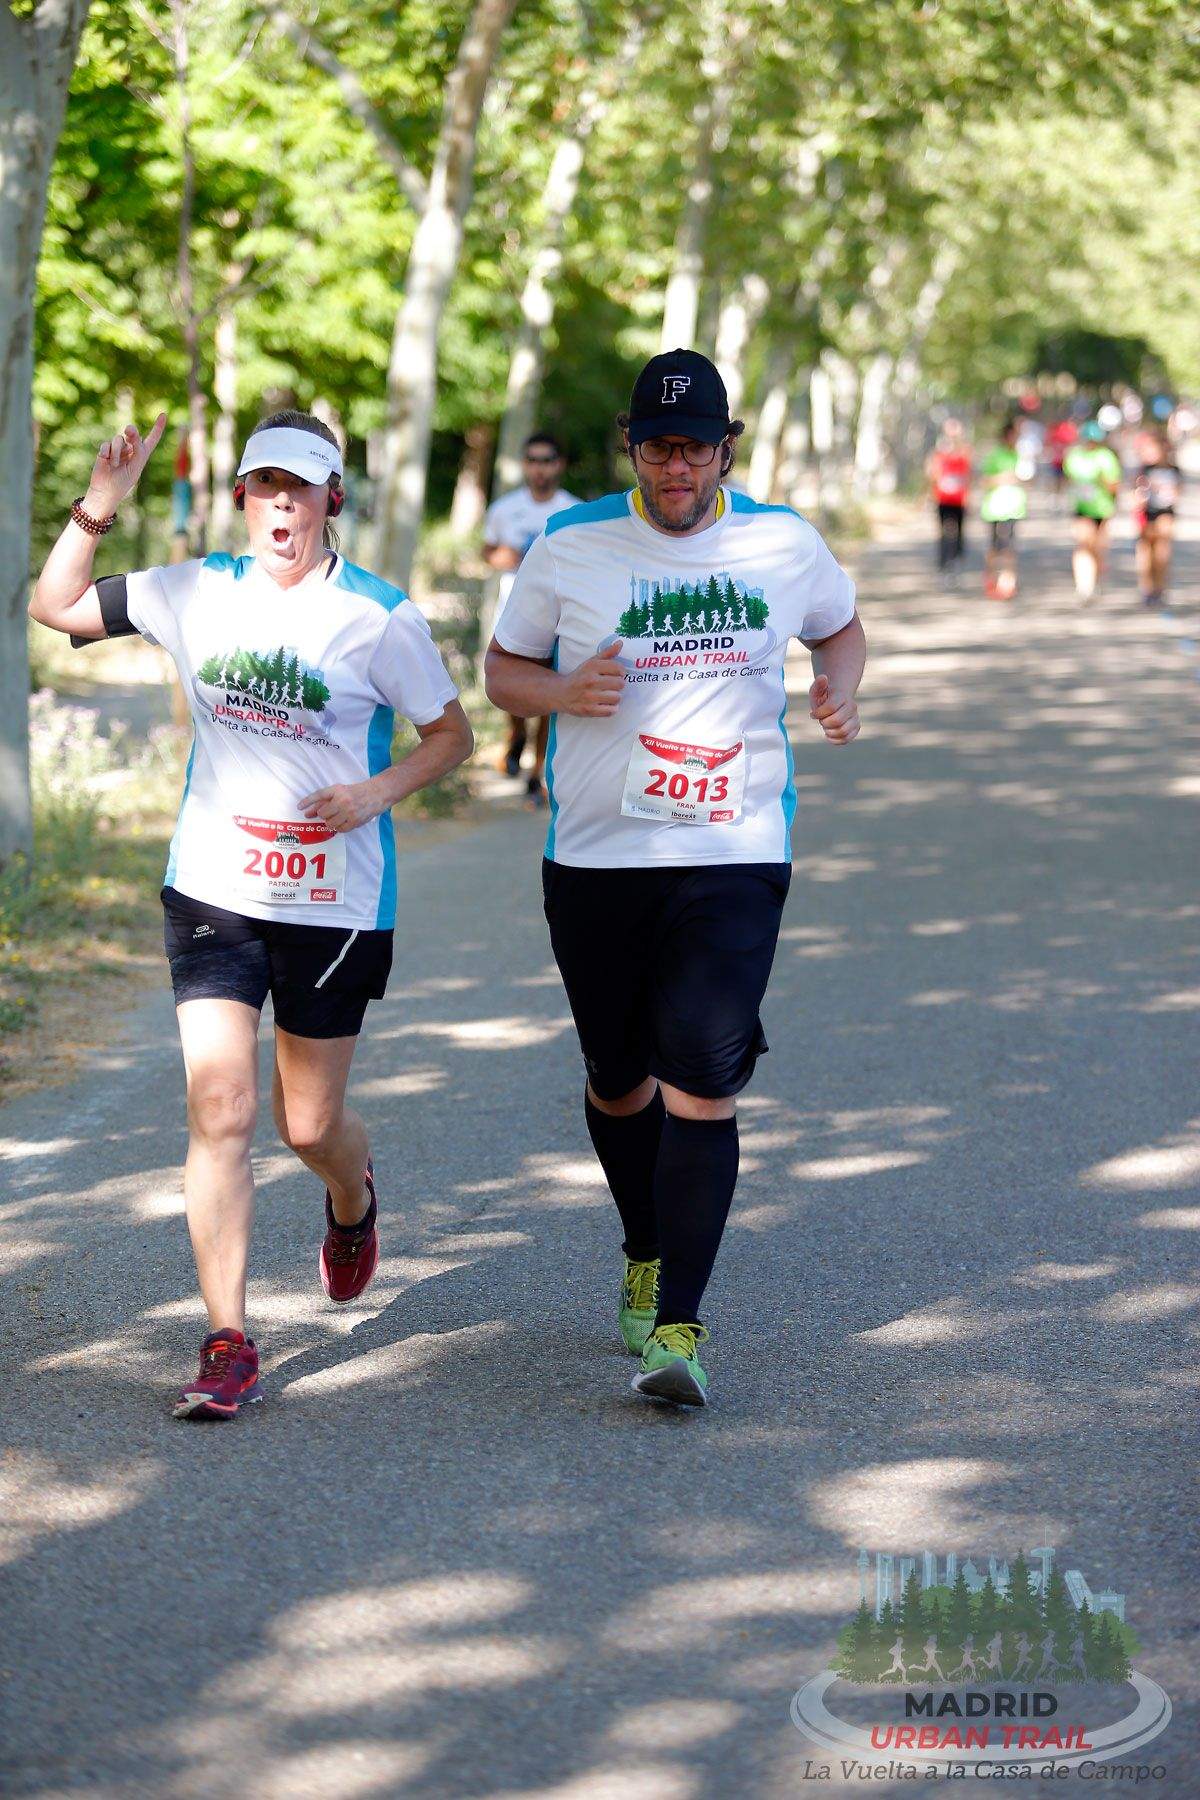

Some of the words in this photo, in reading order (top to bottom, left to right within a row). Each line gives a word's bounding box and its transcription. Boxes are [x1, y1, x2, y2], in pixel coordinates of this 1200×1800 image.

[661, 375, 691, 404] F
[653, 636, 735, 654] MADRID
[635, 654, 697, 669] URBAN
[703, 650, 750, 665] TRAIL
[662, 673, 670, 682] a
[673, 670, 684, 681] la
[687, 669, 718, 680] Casa
[721, 667, 737, 677] de
[740, 666, 769, 677] Campo
[214, 704, 267, 723] URBAN
[225, 693, 290, 721] MADRID
[241, 724, 249, 733] a
[656, 741, 679, 751] Vuelta
[643, 768, 729, 803] 2013
[676, 802, 696, 810] FRAN
[243, 848, 326, 880] 2001
